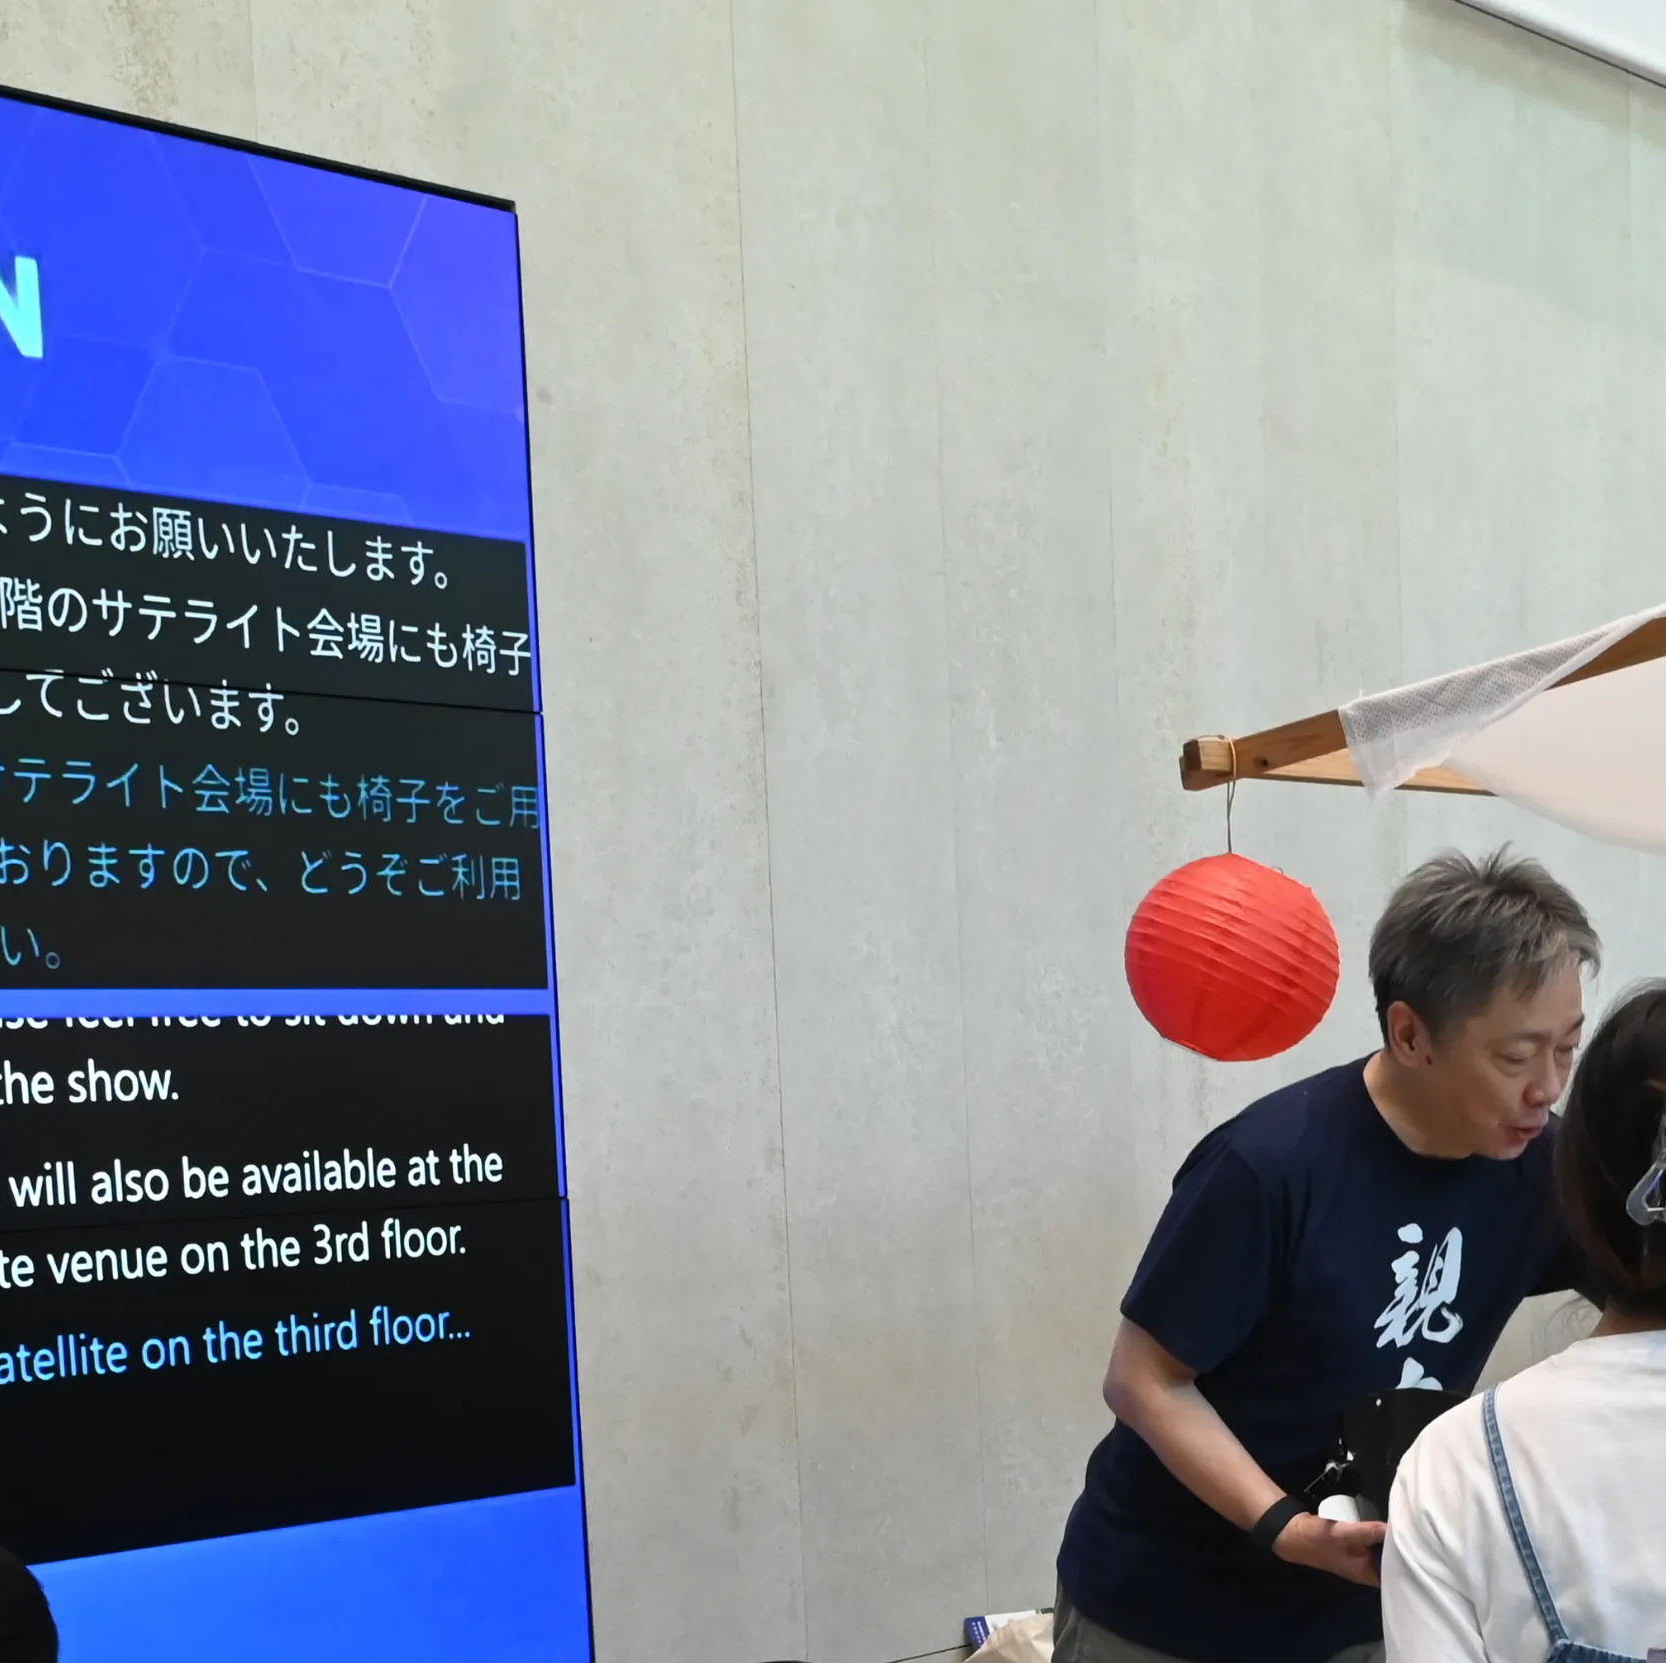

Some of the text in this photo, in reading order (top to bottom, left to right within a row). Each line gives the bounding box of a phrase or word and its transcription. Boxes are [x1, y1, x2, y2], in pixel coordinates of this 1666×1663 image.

[68, 1058, 179, 1103] show.
[9, 1161, 76, 1208] will
[92, 1158, 170, 1204] also
[182, 1155, 230, 1199] be
[241, 1148, 397, 1195] available
[407, 1150, 441, 1186] at
[448, 1143, 503, 1184] the
[47, 1246, 168, 1284] venue
[181, 1242, 230, 1274] on
[241, 1228, 301, 1269] the
[313, 1220, 370, 1265] 3rd
[381, 1217, 467, 1260] floor.
[141, 1336, 191, 1369] on
[202, 1321, 264, 1363] the
[274, 1309, 358, 1357] third
[369, 1306, 472, 1346] floor...
